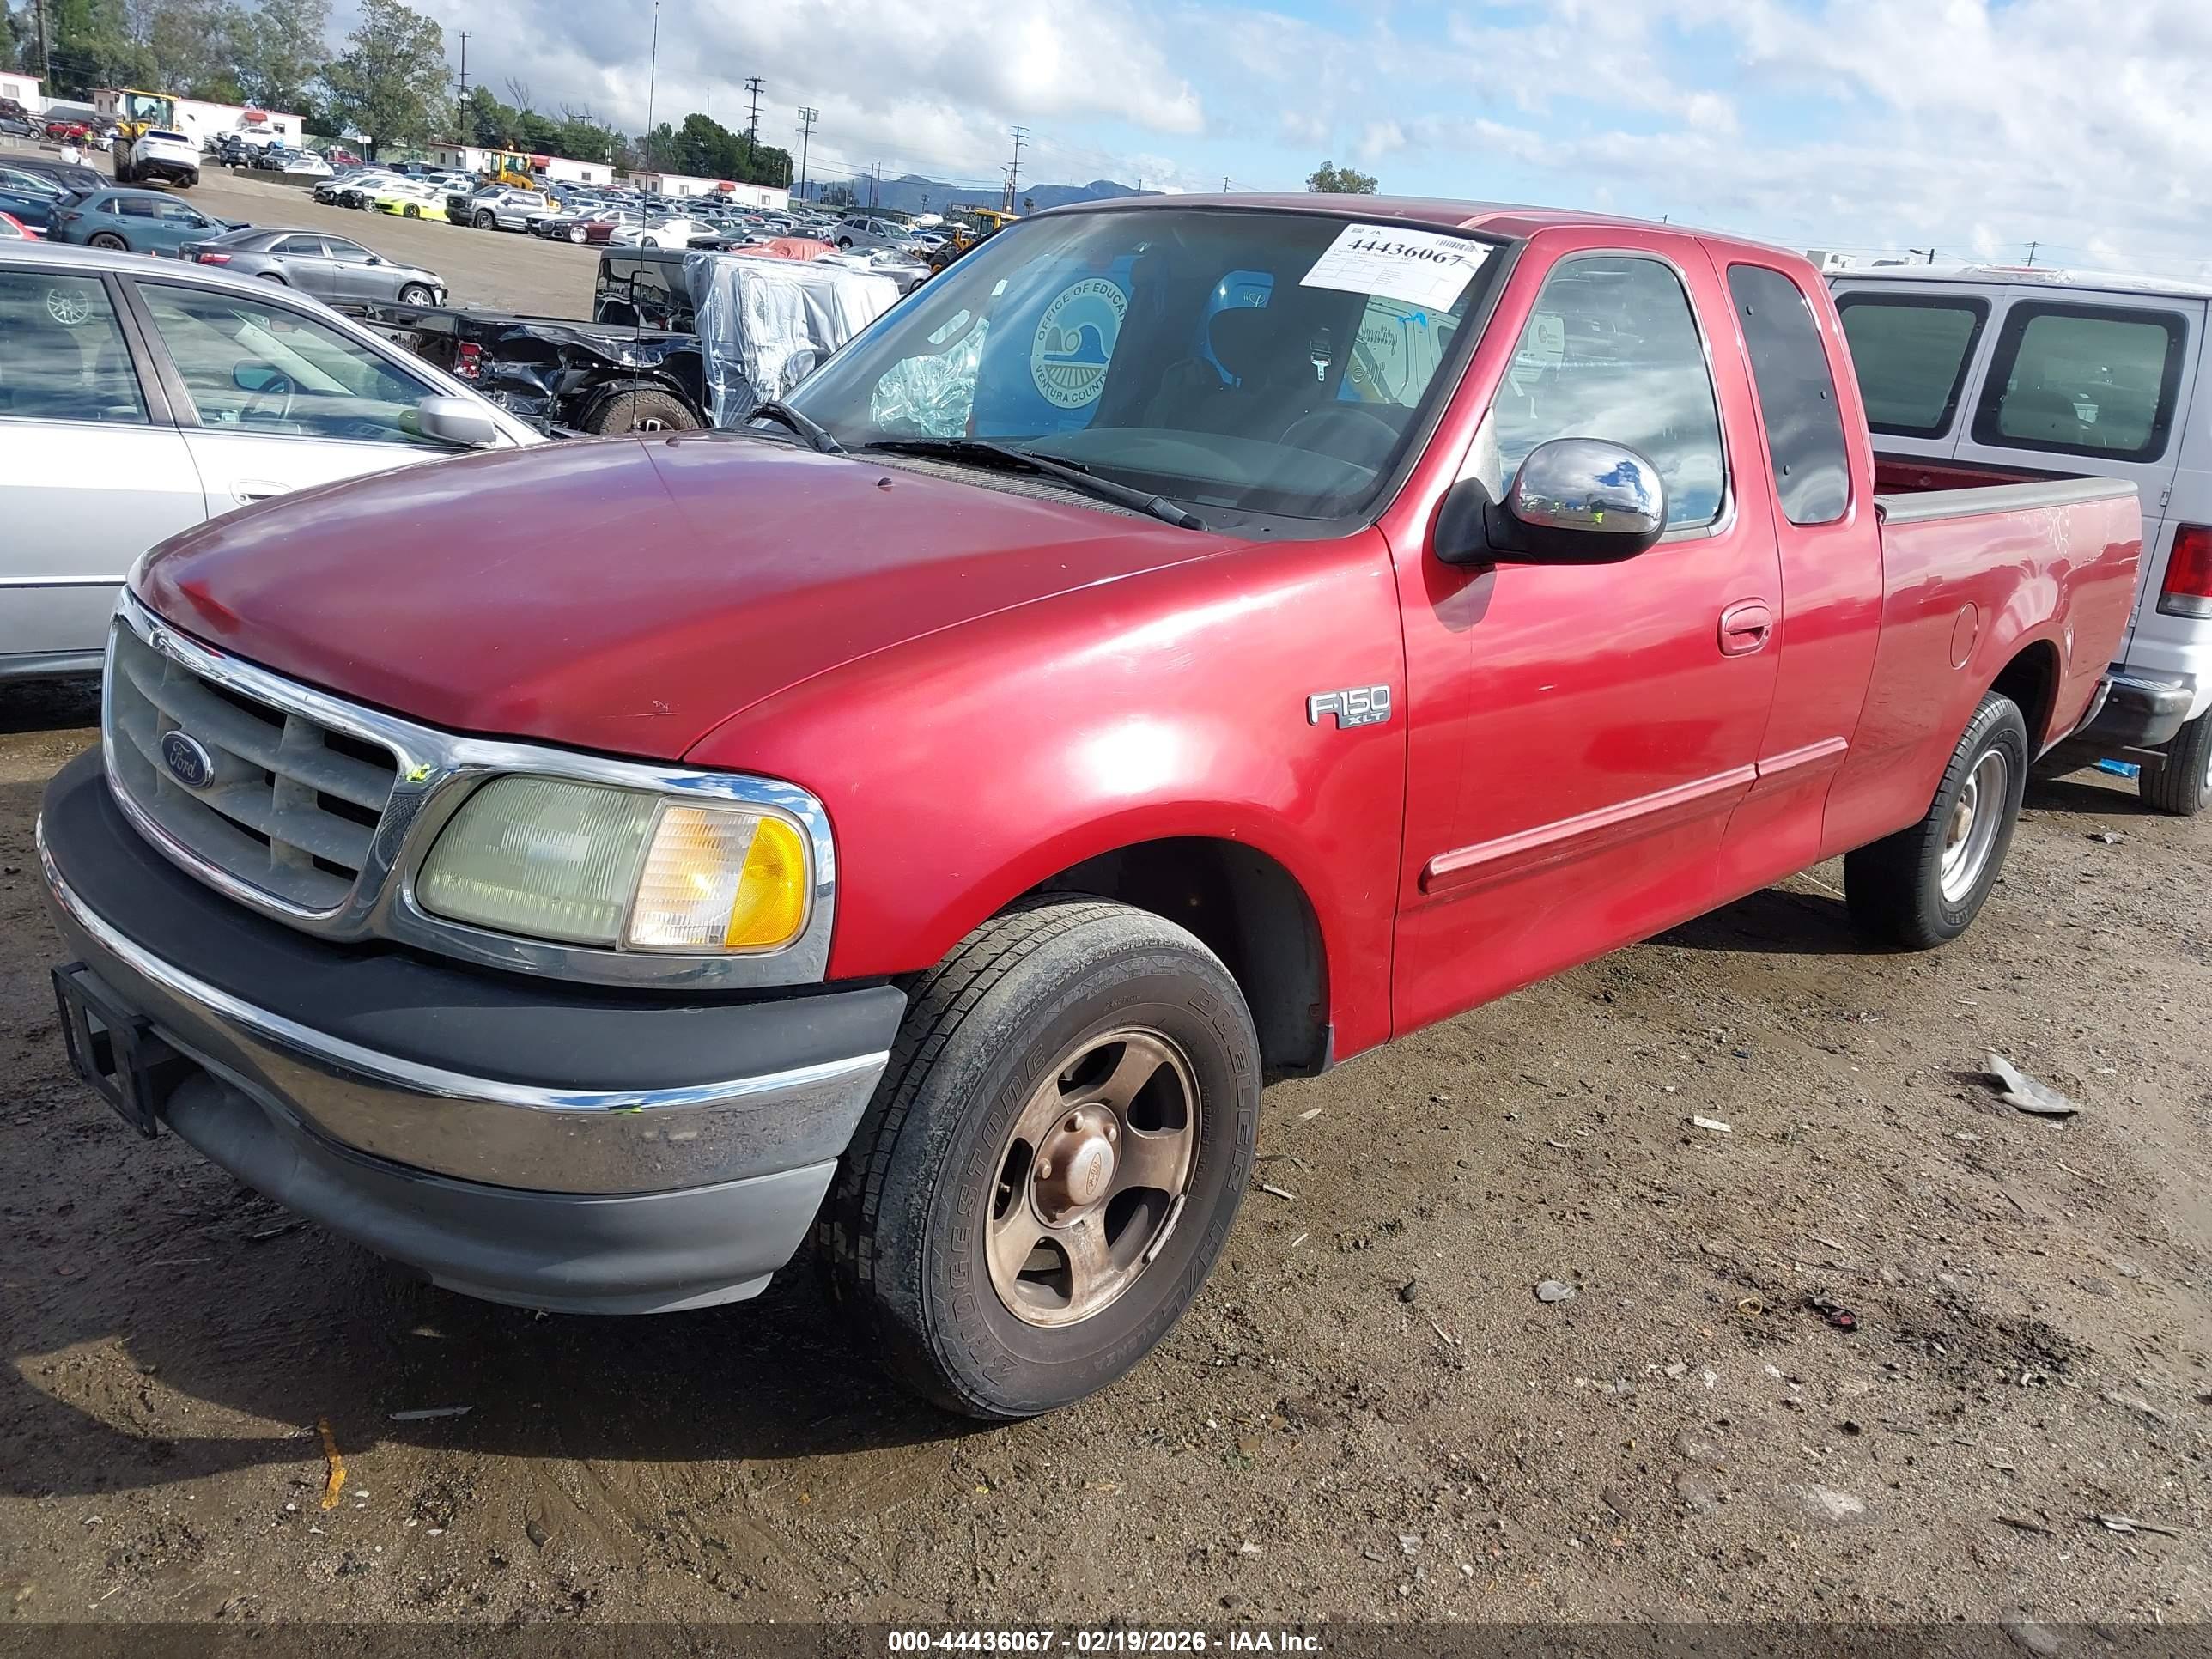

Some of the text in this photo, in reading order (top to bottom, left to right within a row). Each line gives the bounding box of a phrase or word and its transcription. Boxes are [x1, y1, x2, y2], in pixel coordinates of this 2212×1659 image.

[1347, 239, 1466, 266] 44436067
[1037, 294, 1071, 341] OFFICE
[1073, 283, 1090, 296] OF
[1036, 365, 1069, 403] VENTURA
[1310, 685, 1390, 724] F-150
[1347, 713, 1384, 726] XLT
[169, 740, 198, 779] Ford
[1188, 987, 1252, 1193] DUELER
[949, 1042, 1048, 1387] BRIDGESTONE
